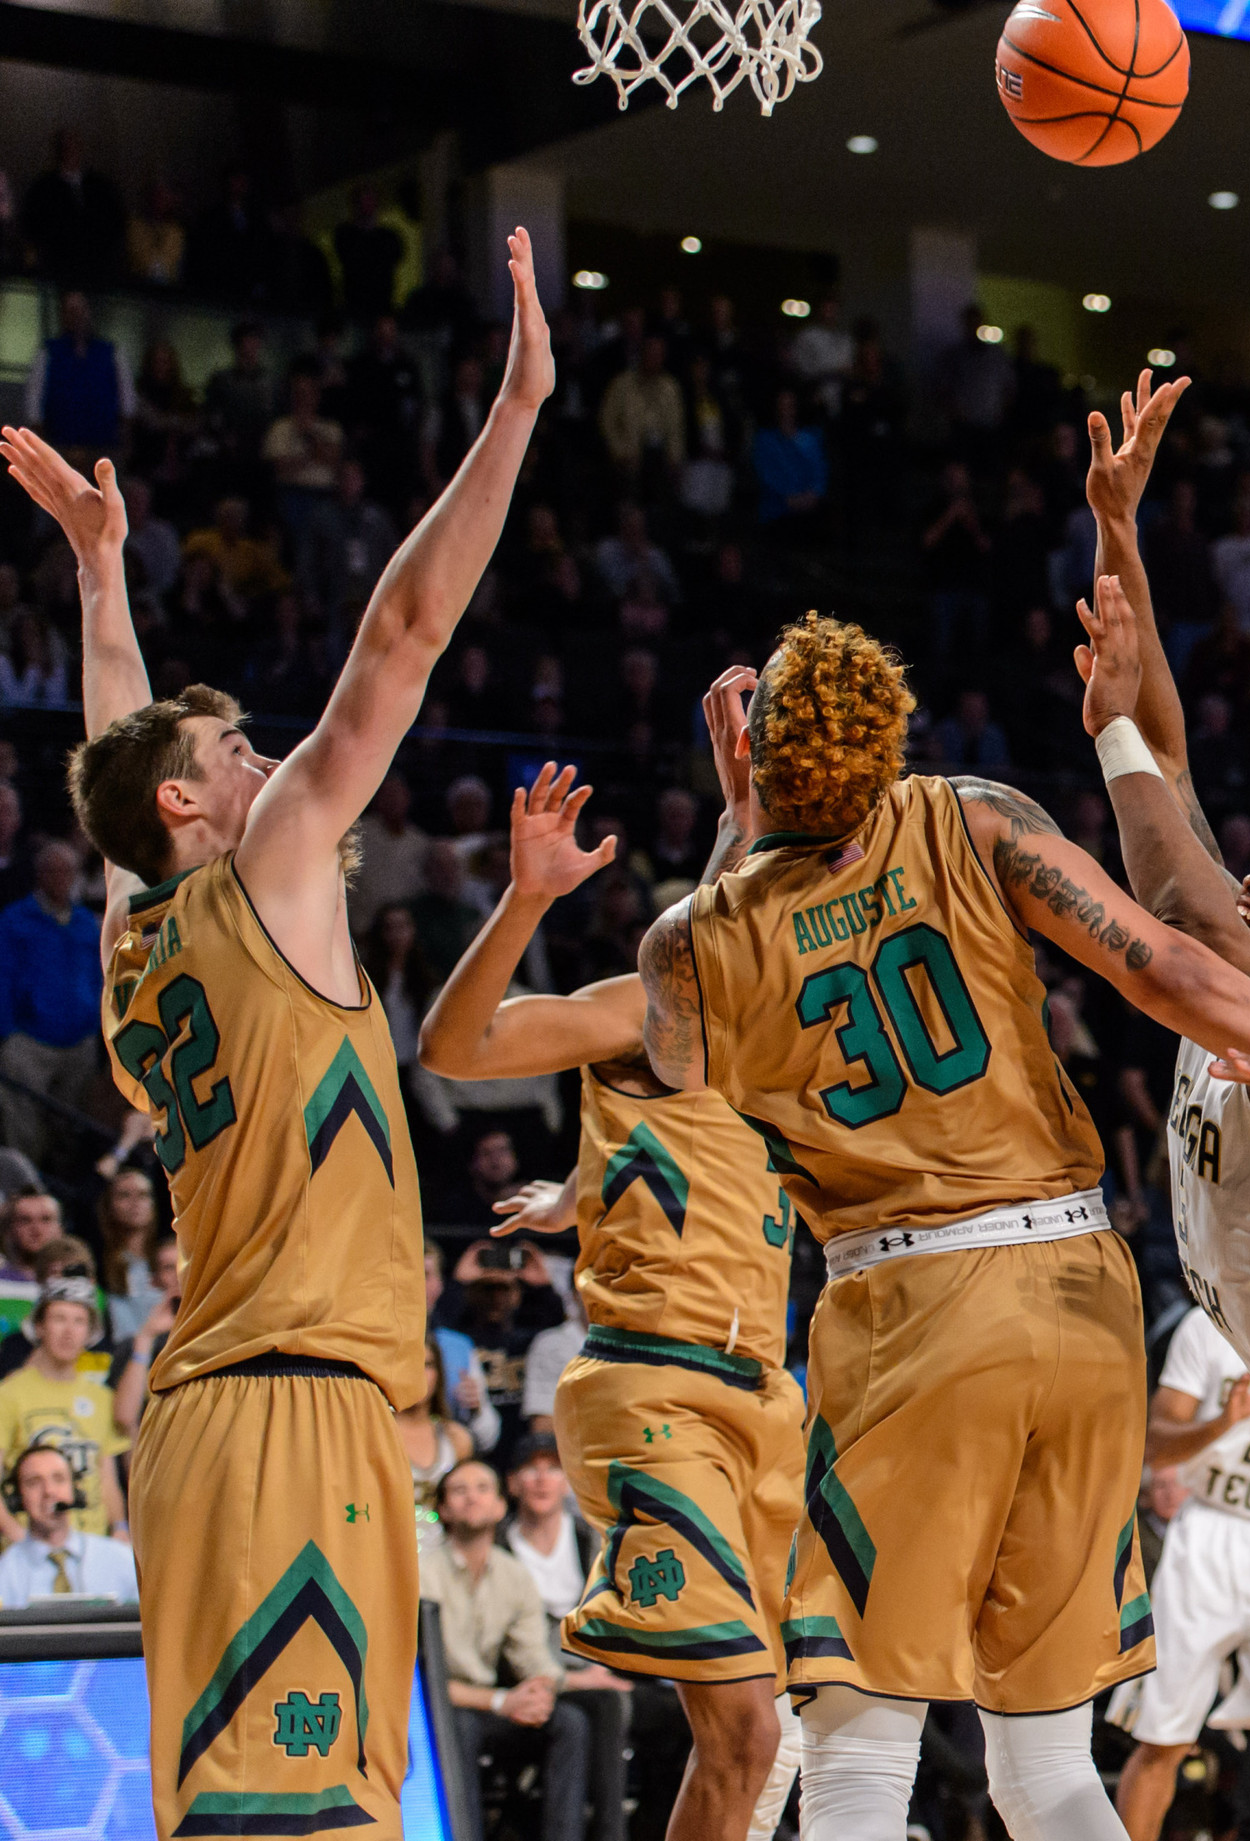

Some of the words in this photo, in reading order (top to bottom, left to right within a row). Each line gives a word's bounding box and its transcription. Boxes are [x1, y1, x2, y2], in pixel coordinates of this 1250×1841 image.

[792, 866, 917, 955] AUGUSTE
[794, 921, 993, 1131] 30
[112, 972, 238, 1175] 32
[917, 1224, 975, 1242] ARMOUR
[978, 1219, 1019, 1234] UNDER
